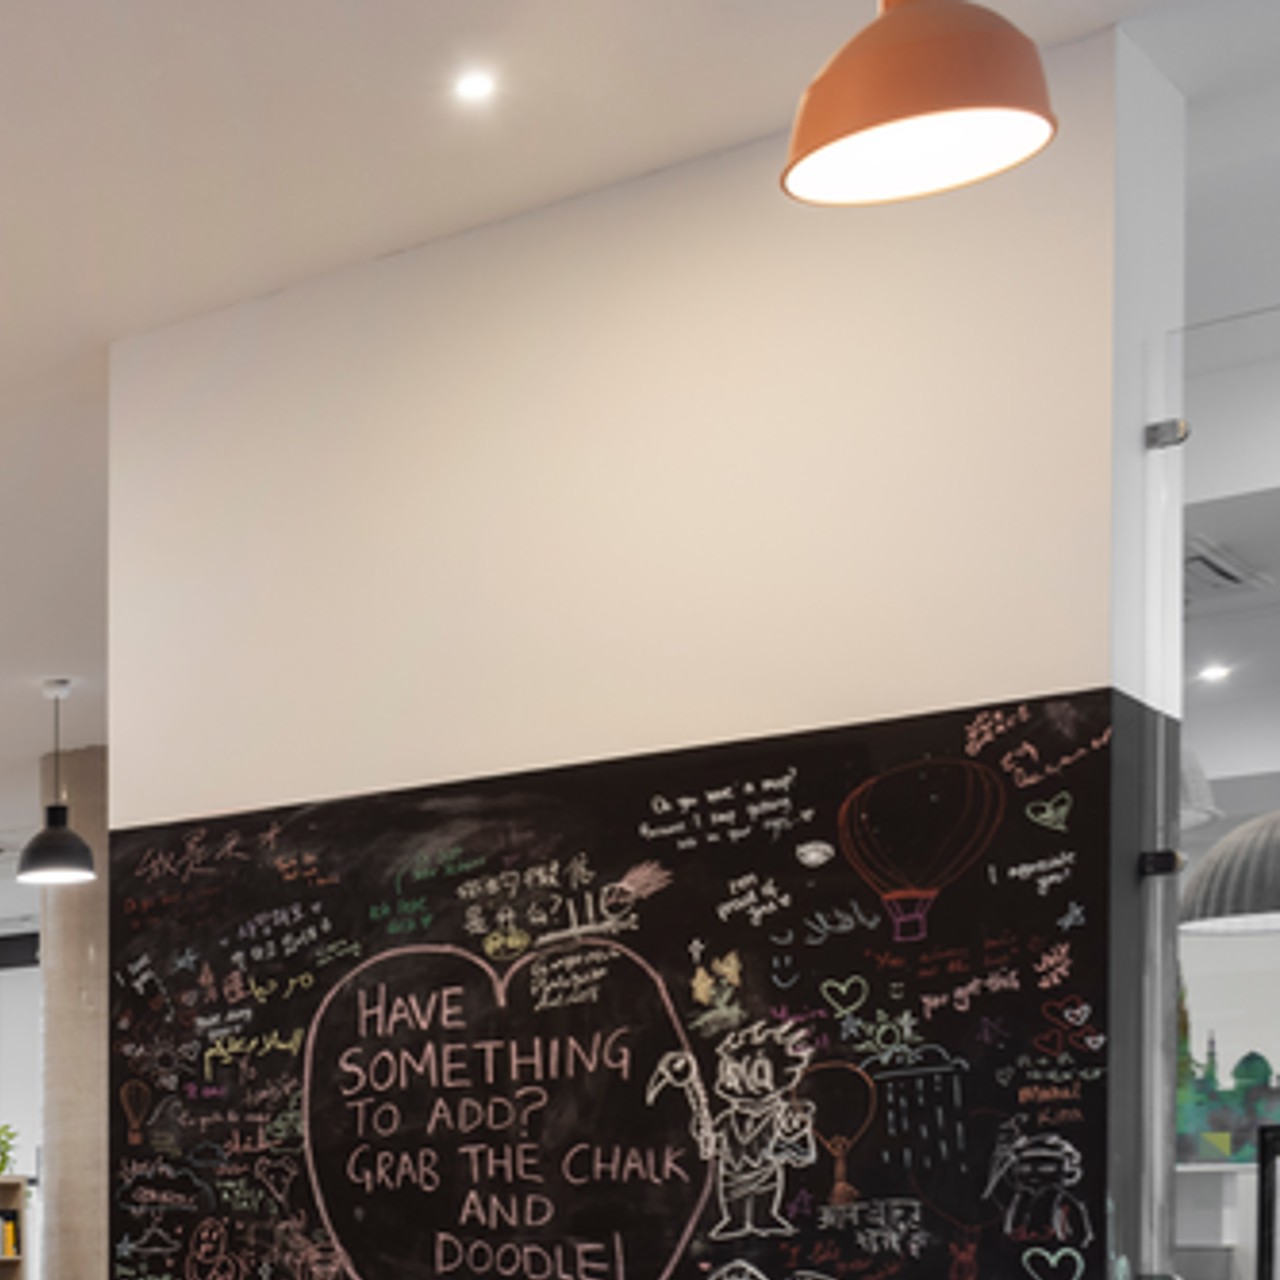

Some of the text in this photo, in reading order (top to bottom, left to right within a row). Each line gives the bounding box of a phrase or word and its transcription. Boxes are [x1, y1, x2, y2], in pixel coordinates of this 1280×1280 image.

[356, 982, 467, 1038] HAVE
[339, 1027, 632, 1096] SOMETHING
[346, 1086, 549, 1138] TO ADD?
[346, 1142, 691, 1194] GRAB THE CHALK
[459, 1190, 556, 1230] AND
